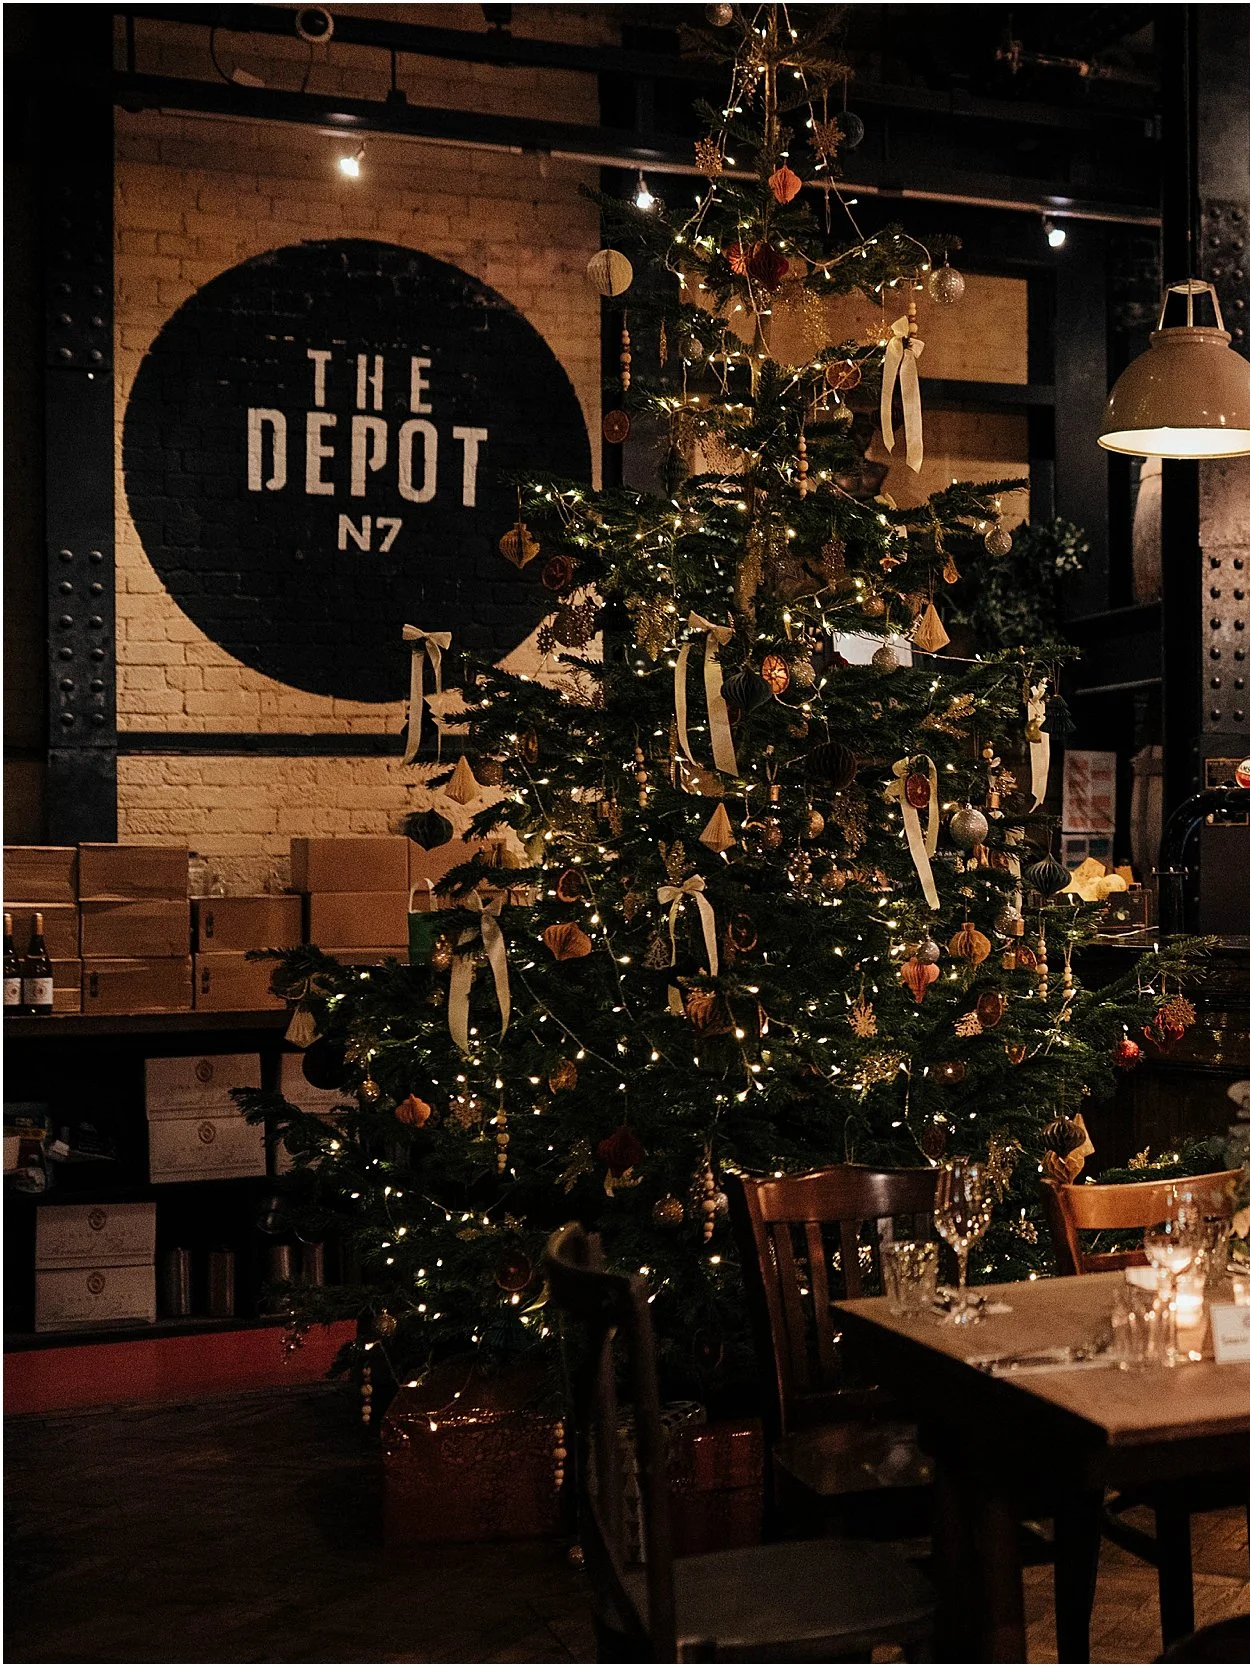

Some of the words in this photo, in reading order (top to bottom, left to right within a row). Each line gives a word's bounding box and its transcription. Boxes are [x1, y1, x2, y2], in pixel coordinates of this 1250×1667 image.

[306, 348, 433, 414] THE
[247, 406, 489, 508] DEPOT
[337, 512, 404, 553] N7
